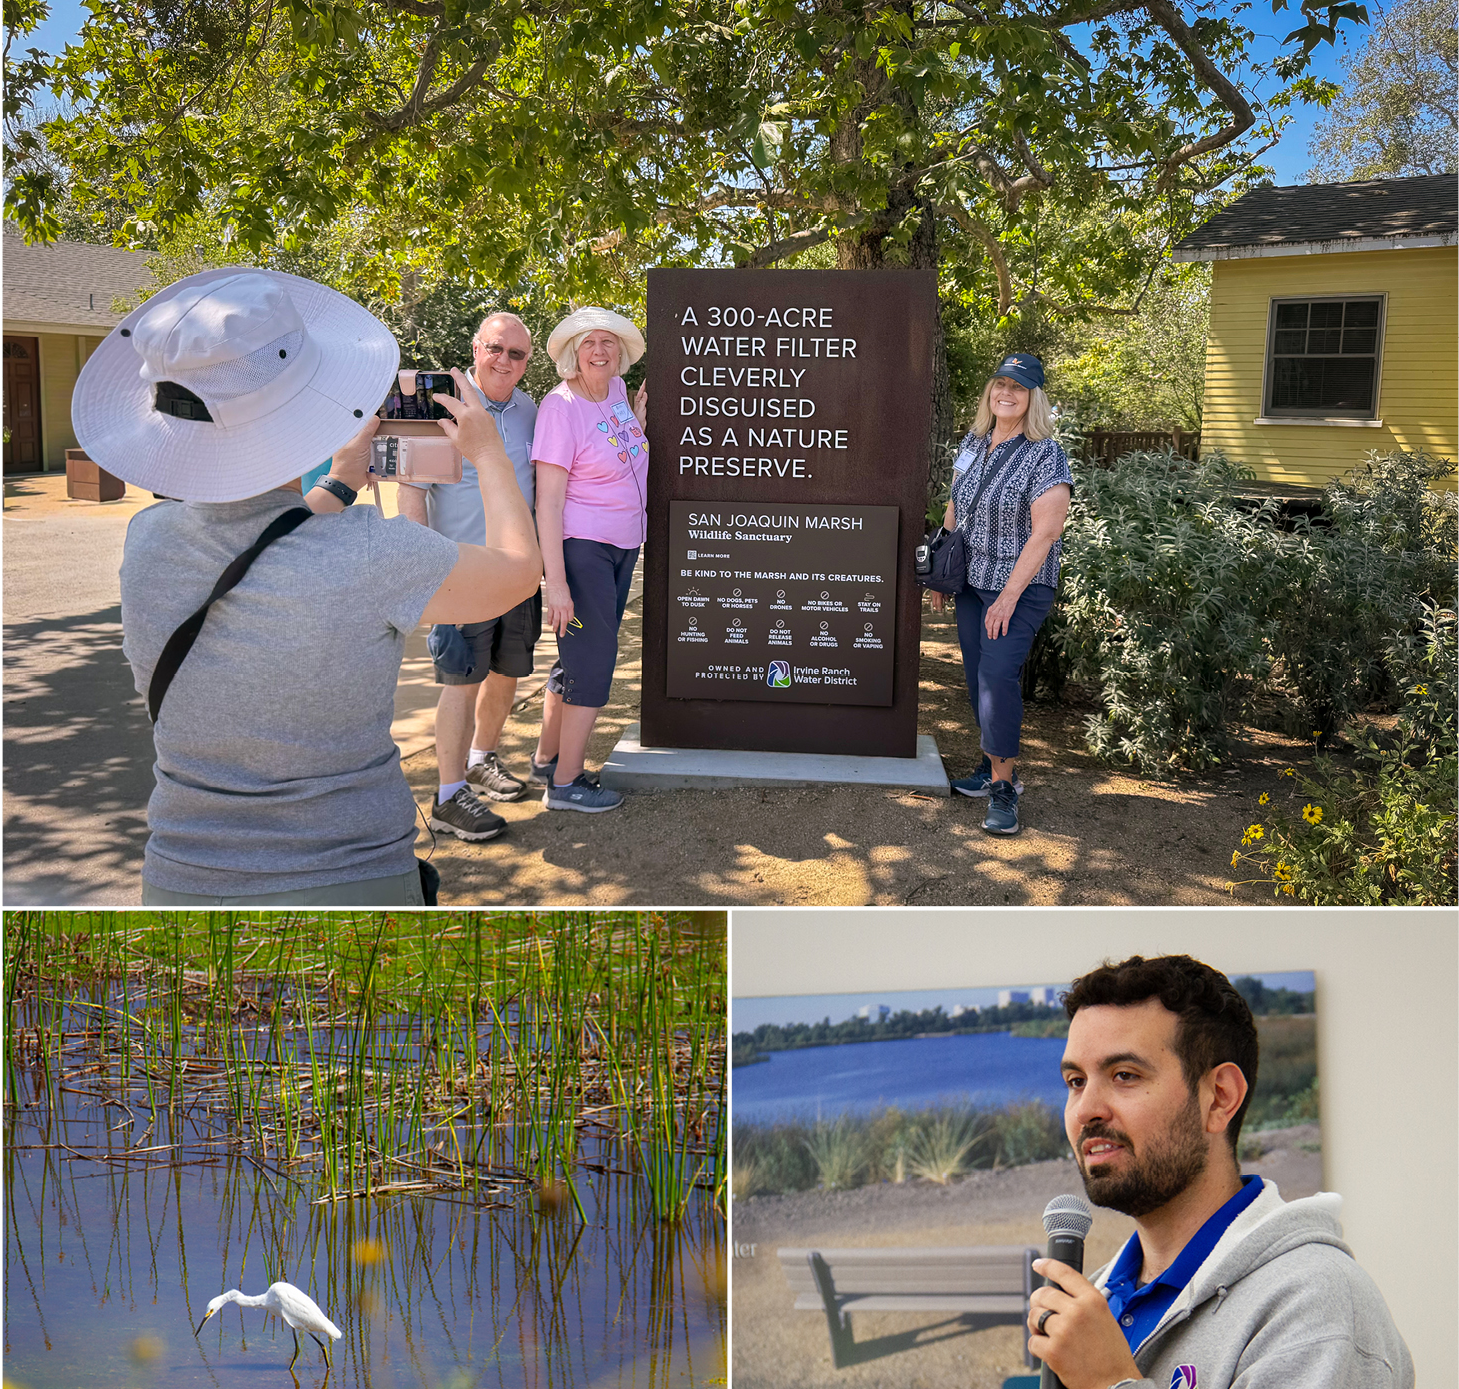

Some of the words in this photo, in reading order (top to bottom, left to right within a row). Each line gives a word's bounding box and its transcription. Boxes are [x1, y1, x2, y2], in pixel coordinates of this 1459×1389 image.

[681, 307, 699, 326] A
[707, 307, 833, 328] 300-ACRE
[681, 336, 767, 358] WATER
[776, 338, 857, 359] FILTER
[680, 367, 806, 389] CLEVERLY
[680, 397, 815, 419] DISGUISED
[679, 427, 713, 447] AS
[721, 428, 739, 447] A
[748, 428, 848, 450] NATURE
[679, 456, 813, 479] PRESERVE.
[688, 513, 721, 527] SAN
[726, 514, 799, 529] JOAQUIN
[805, 516, 863, 530] MARSH
[688, 529, 732, 540] Wildlife
[735, 531, 792, 544] Sanctuary
[680, 569, 693, 577] BE
[694, 570, 717, 578] KIND
[719, 570, 732, 578] TO
[734, 571, 752, 579] THE
[754, 572, 787, 580] MARSH
[789, 572, 809, 581] AND
[811, 573, 826, 581] ITS
[828, 574, 884, 583] CREATURES.
[753, 673, 764, 681] BY
[793, 666, 819, 675] Irvine
[822, 667, 850, 676] Ranch
[794, 675, 821, 684] Water
[824, 676, 857, 686] District
